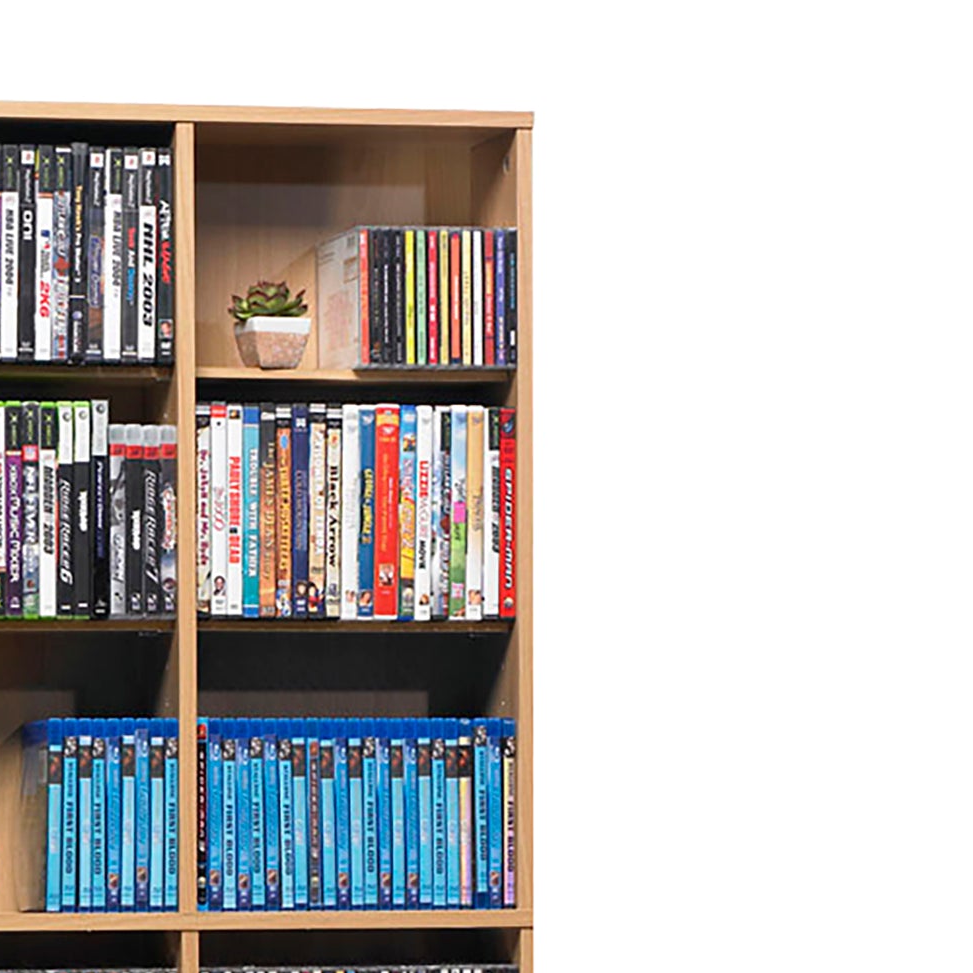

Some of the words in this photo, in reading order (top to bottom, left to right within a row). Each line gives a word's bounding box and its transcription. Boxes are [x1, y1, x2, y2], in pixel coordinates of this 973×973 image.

[143, 222, 153, 268] NHL
[143, 273, 153, 327] 2003
[328, 465, 338, 511] Black
[328, 515, 338, 568] Arrow
